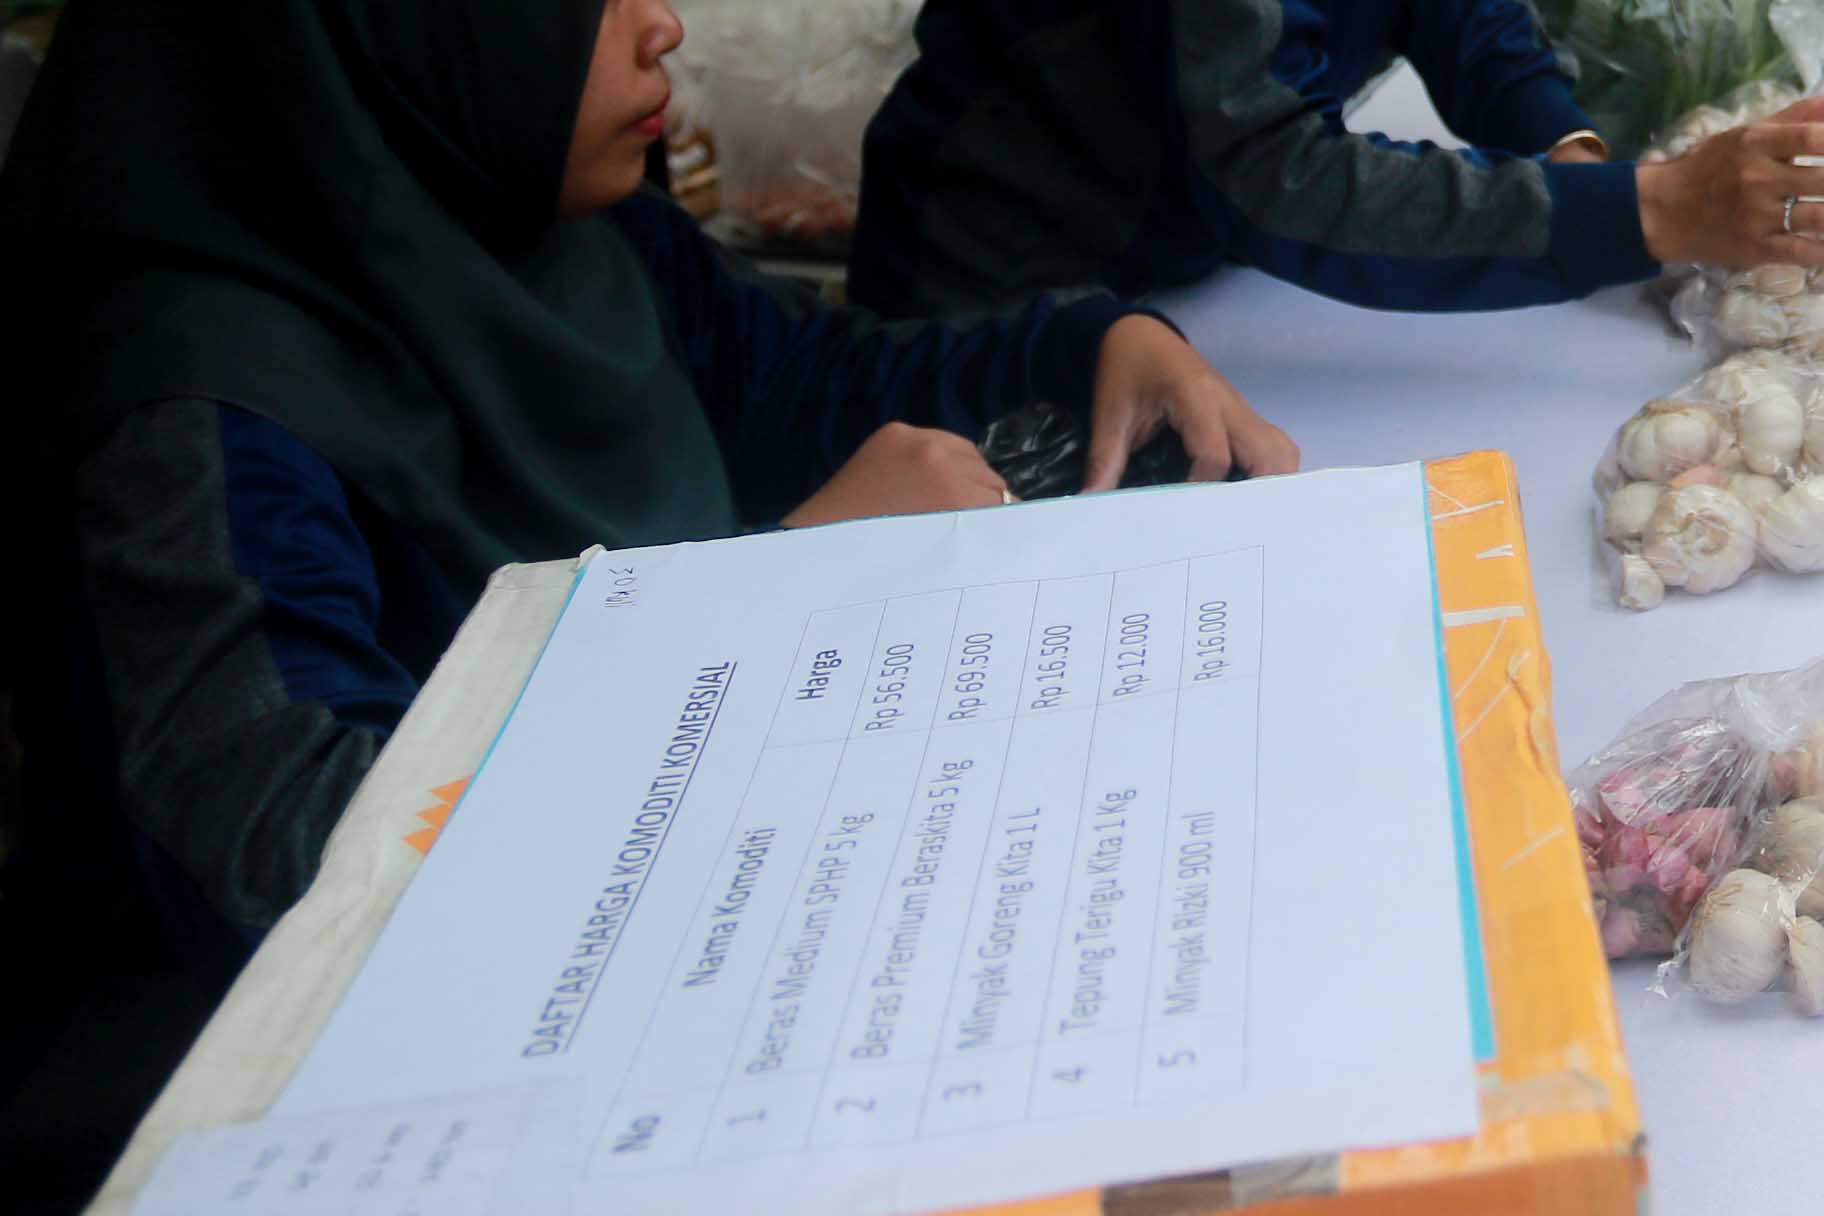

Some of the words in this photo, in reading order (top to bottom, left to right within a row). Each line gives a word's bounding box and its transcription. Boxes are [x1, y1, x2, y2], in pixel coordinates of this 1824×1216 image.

[1116, 613, 1150, 670] 12.000
[1196, 600, 1227, 657] 16.000
[954, 632, 993, 693] 69.500
[1036, 625, 1072, 682] 16.500
[1193, 660, 1231, 681] Rp
[795, 649, 842, 700] Harga
[873, 644, 914, 704] 56.500
[1112, 674, 1152, 697] Rp
[948, 697, 987, 721] Rp
[1030, 686, 1071, 710] Rp
[864, 708, 905, 731] Rp
[929, 759, 974, 783] kg
[928, 786, 959, 798] 5
[1095, 789, 1137, 817] Kg
[828, 812, 875, 837] kg
[1005, 823, 1038, 834] 1
[1008, 807, 1040, 821] L
[1093, 818, 1126, 832] 1
[1181, 810, 1215, 837] ml
[520, 962, 598, 1059] DAFTAR
[570, 880, 639, 960] HARGA
[610, 773, 686, 876] KOMODITI
[659, 661, 731, 769] KOMERSIAL
[824, 839, 858, 853] 5
[900, 803, 956, 887] Beraskita
[996, 840, 1034, 879] Kita
[1087, 836, 1124, 875] Kita
[1177, 841, 1213, 881] 900
[805, 854, 850, 908] SPHP
[682, 919, 739, 989] Nama
[711, 827, 777, 918] Komoditi
[977, 880, 1034, 960] Goreng
[1074, 878, 1125, 944] Terigu
[1170, 882, 1209, 933] Rizki
[769, 908, 832, 1001] Medium
[870, 889, 931, 988] Premium
[1058, 945, 1116, 1035] Tepung
[1162, 933, 1212, 1016] Minyak
[850, 992, 904, 1060] Beras
[956, 963, 1012, 1051] Minyak
[745, 1003, 800, 1076] Beras
[1156, 1048, 1196, 1069] 5
[943, 1082, 983, 1101] 3
[1053, 1066, 1088, 1084] 4
[727, 1109, 767, 1128] 1
[834, 1096, 877, 1113] 2
[612, 1114, 662, 1154] No
